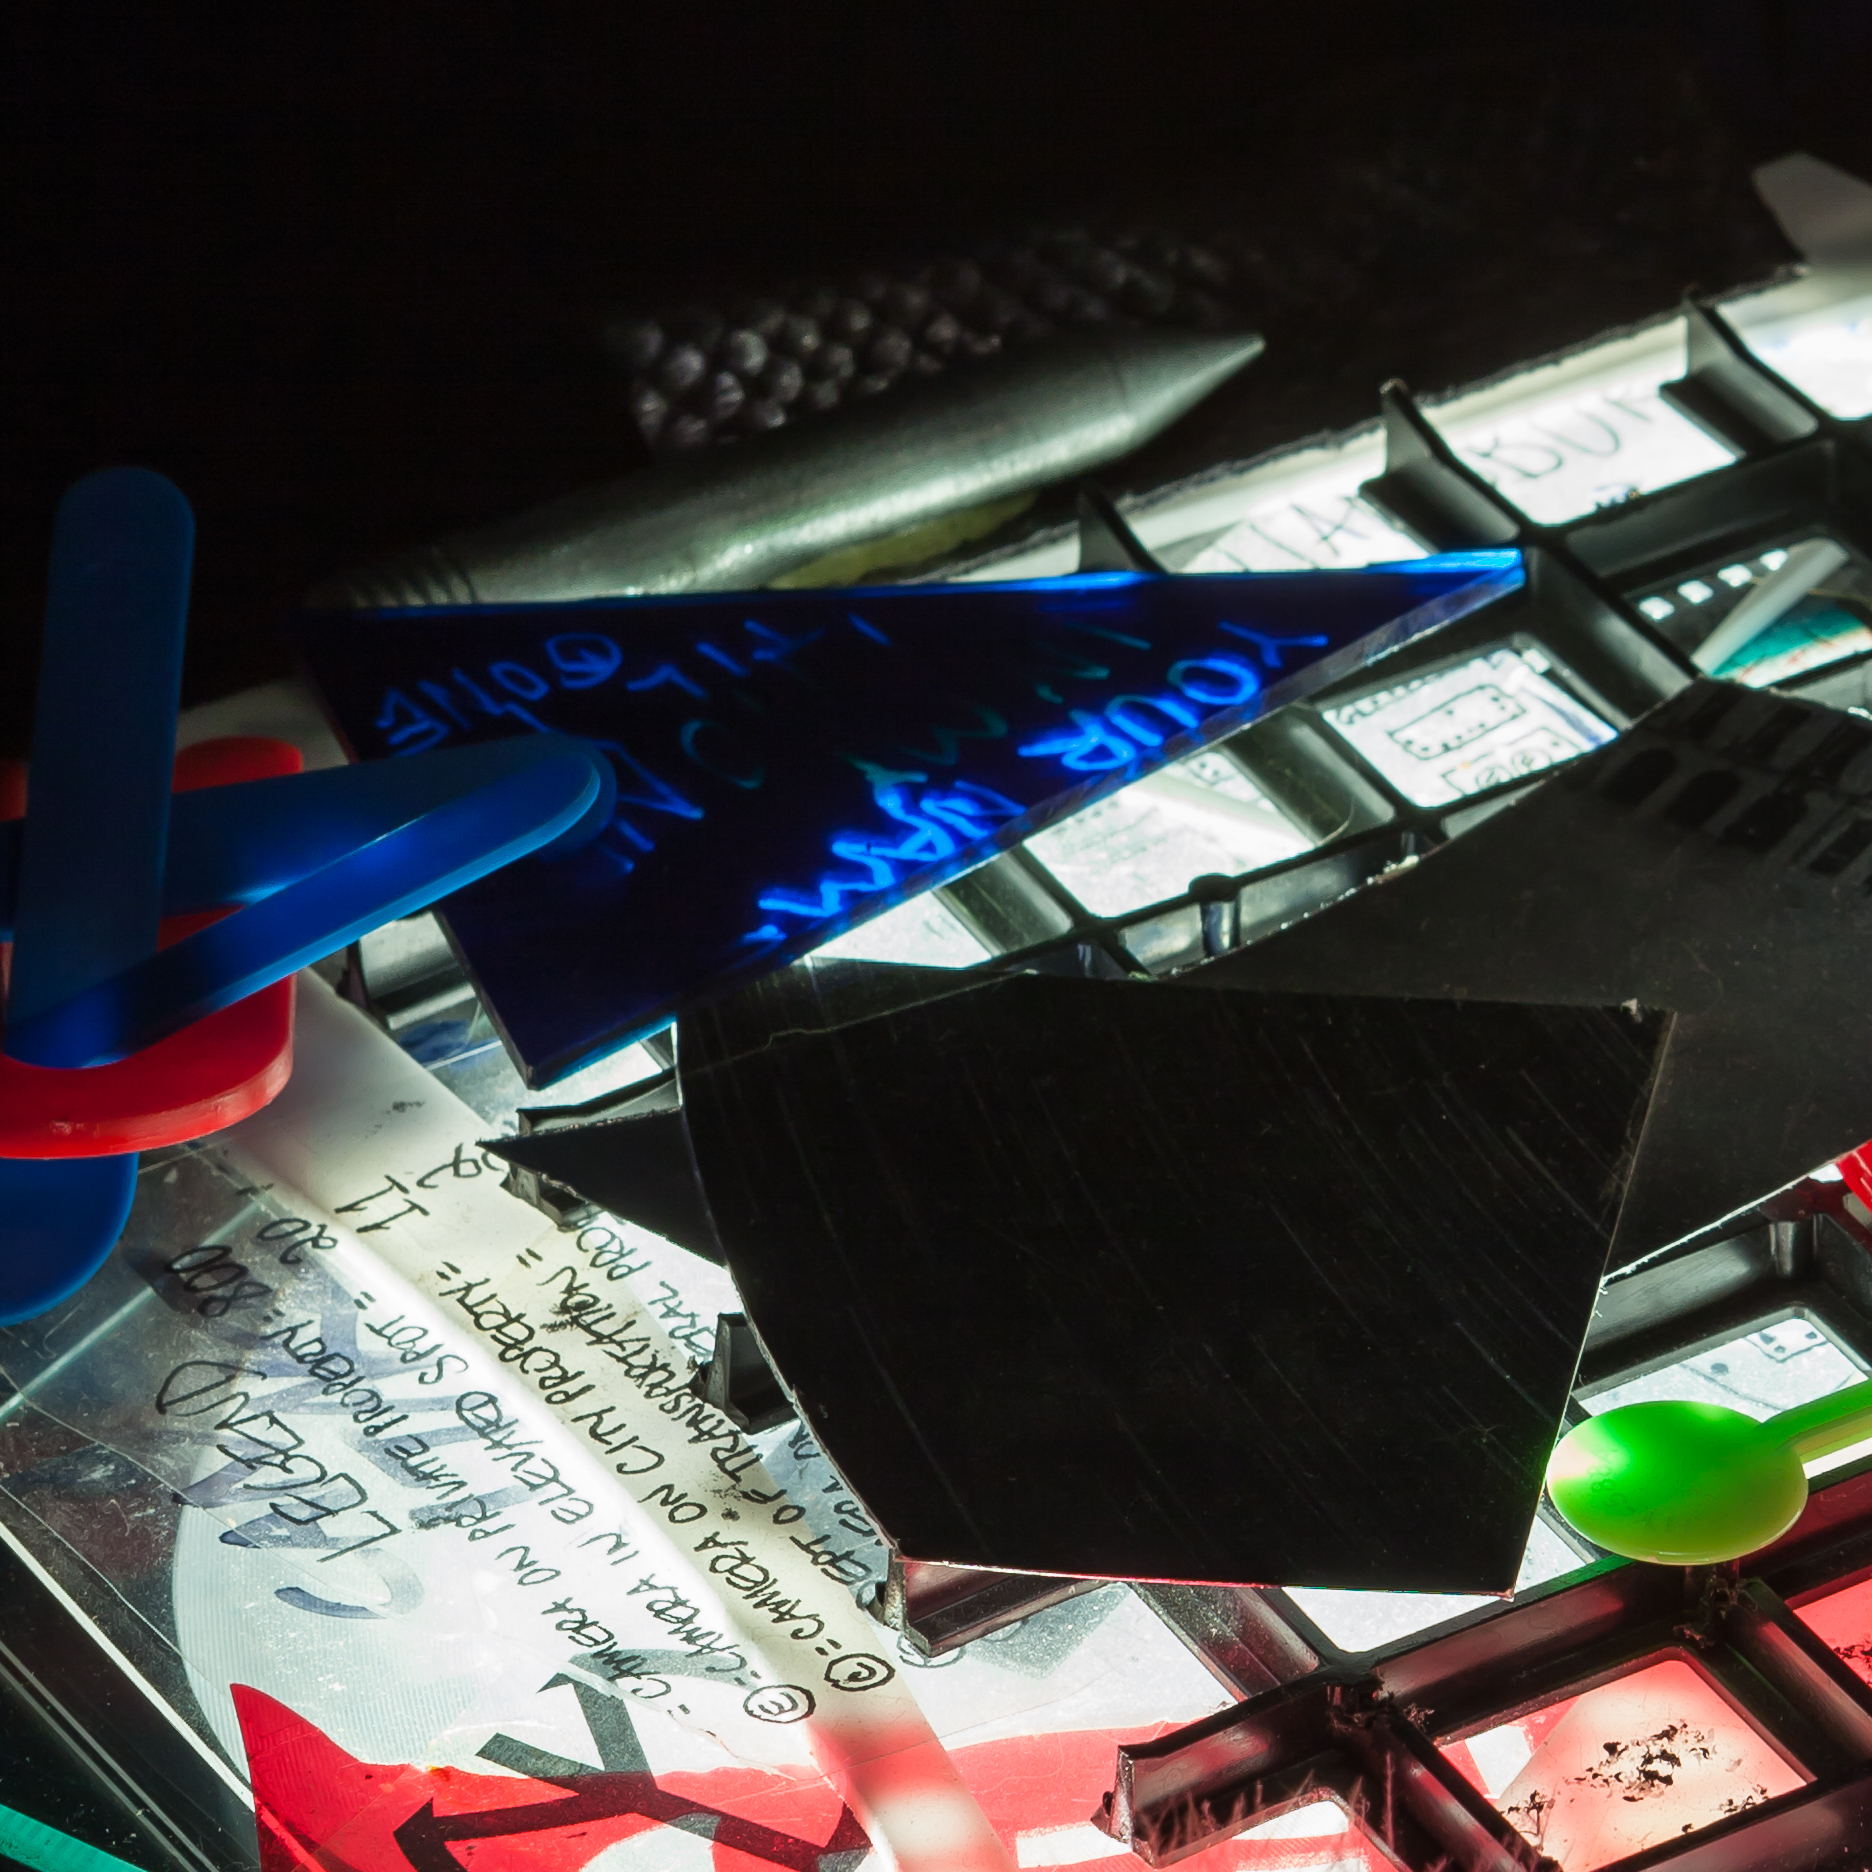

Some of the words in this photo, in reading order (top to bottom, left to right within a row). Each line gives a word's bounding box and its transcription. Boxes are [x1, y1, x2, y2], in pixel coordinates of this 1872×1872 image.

[1018, 621, 1328, 773] YOUR
[740, 780, 1027, 942] NAM
[333, 1174, 431, 1234] 11
[255, 1216, 339, 1266] 20
[164, 1243, 273, 1318] 800
[365, 1314, 470, 1386] SPOT
[536, 1264, 764, 1483] TRANSPORTATION
[155, 1360, 404, 1565] LEGEND
[455, 1390, 594, 1524] ELEVATED
[571, 1405, 665, 1476] CITY
[385, 1434, 517, 1542] PRIVATE
[637, 1483, 708, 1526] ON
[741, 1487, 806, 1526] OF
[496, 1544, 561, 1587] ON
[577, 1529, 639, 1567] IN
[541, 1594, 673, 1702] CAMERA
